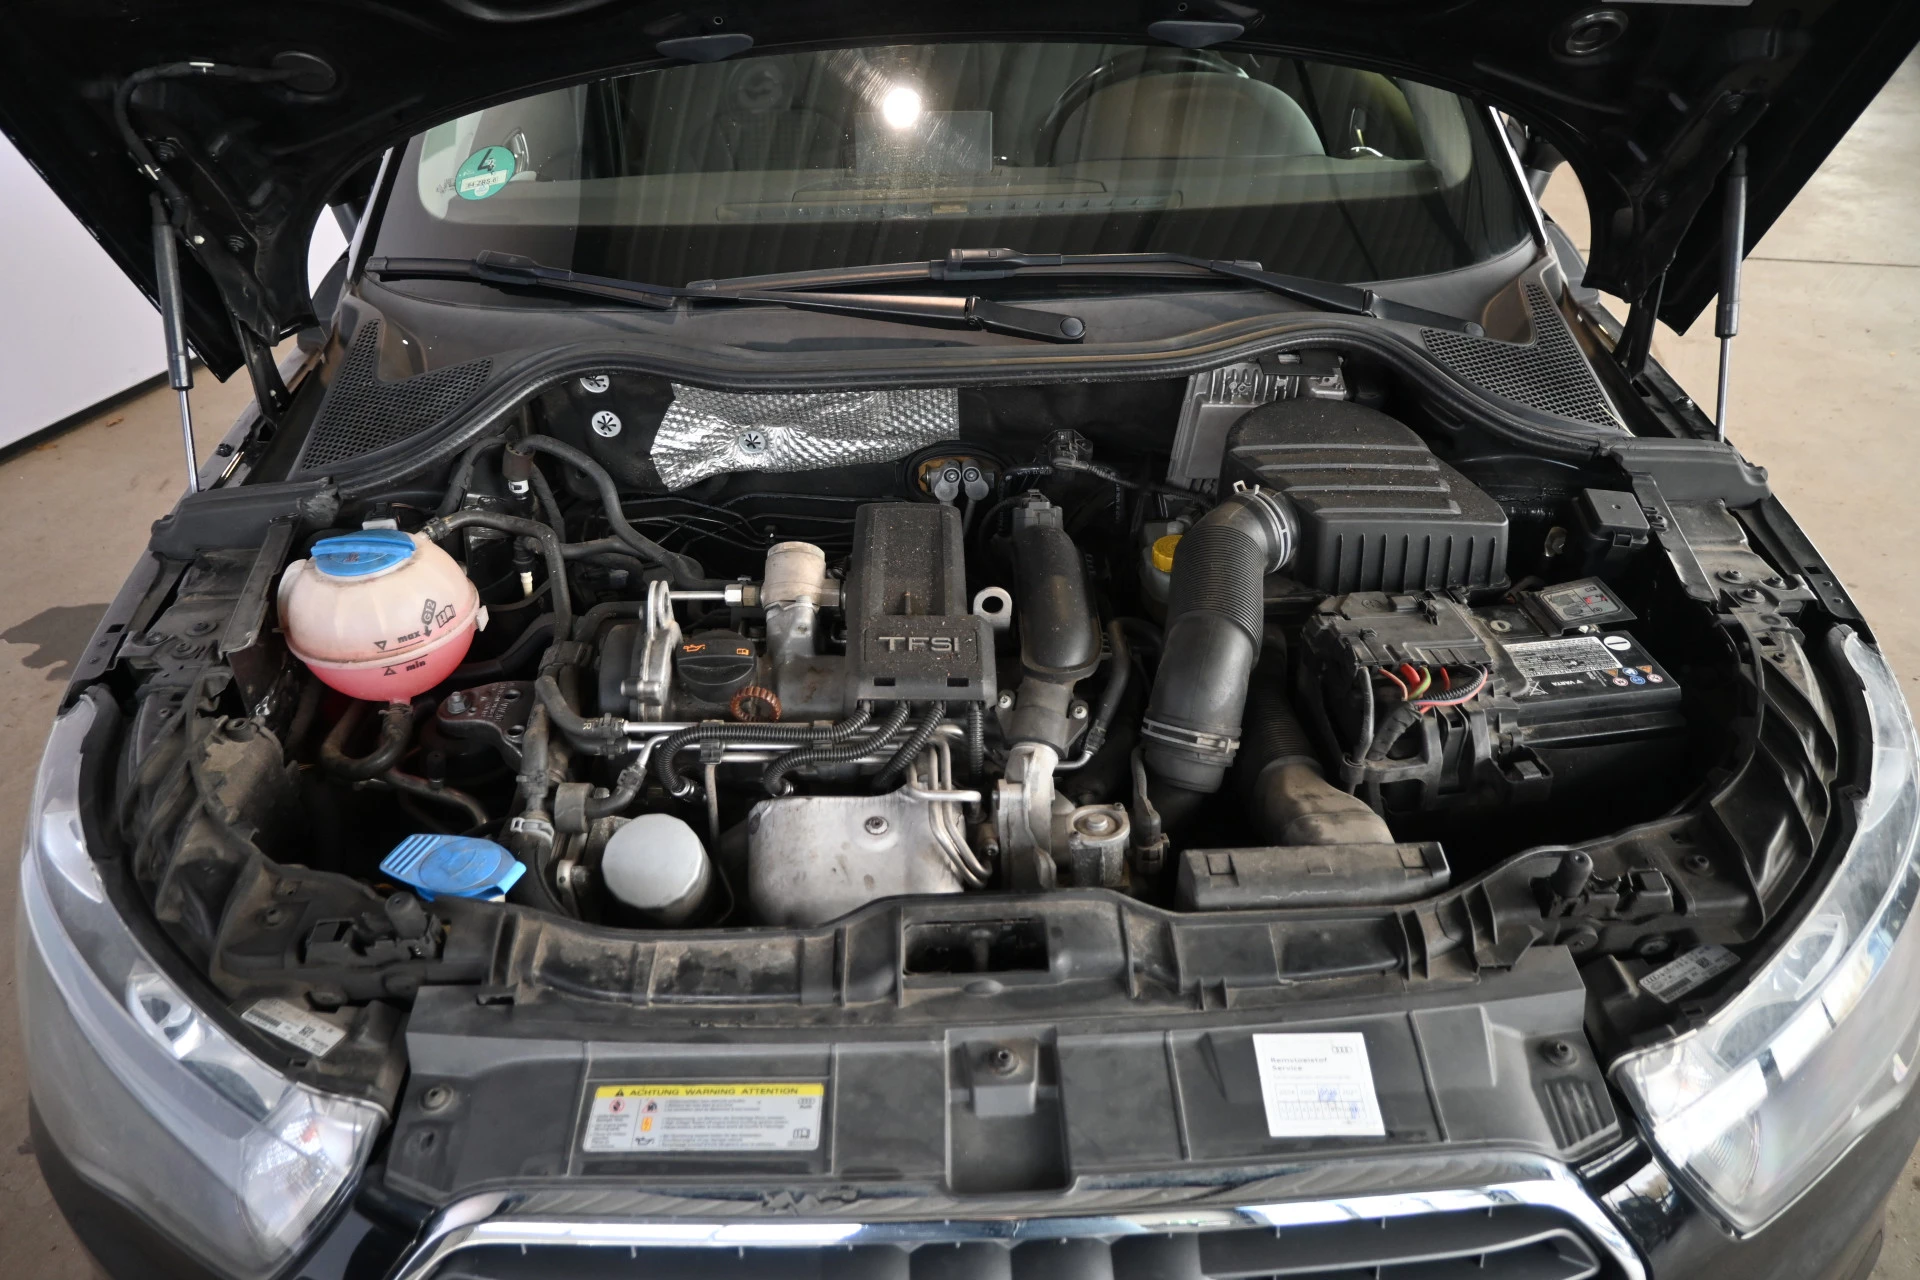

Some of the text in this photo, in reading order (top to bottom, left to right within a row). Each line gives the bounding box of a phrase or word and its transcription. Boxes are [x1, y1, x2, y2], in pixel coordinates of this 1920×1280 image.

[423, 601, 435, 622] G12
[397, 631, 421, 643] max
[878, 636, 960, 652] TFSI
[406, 661, 426, 671] min
[741, 1087, 799, 1095] ATTENTION
